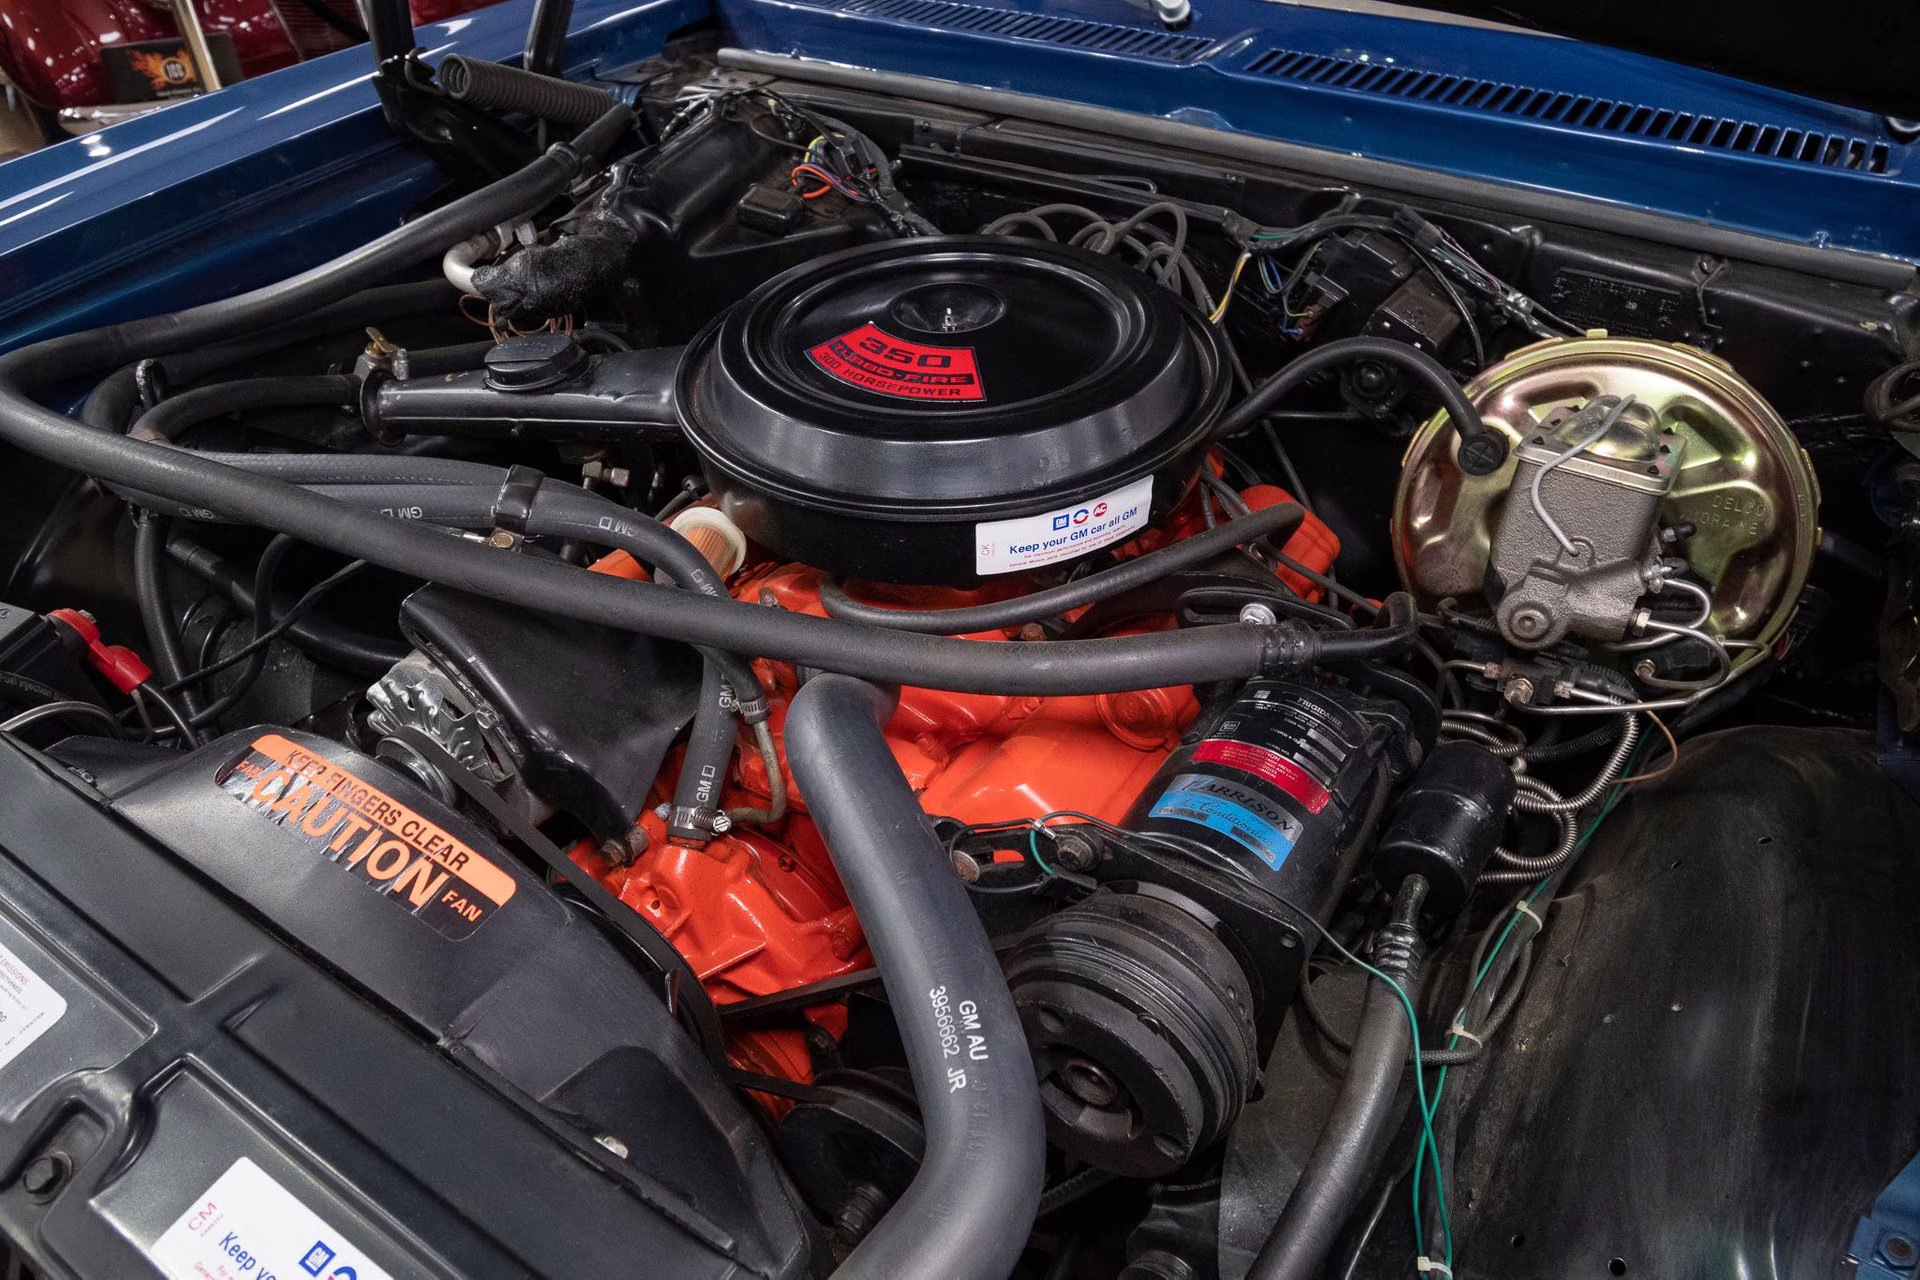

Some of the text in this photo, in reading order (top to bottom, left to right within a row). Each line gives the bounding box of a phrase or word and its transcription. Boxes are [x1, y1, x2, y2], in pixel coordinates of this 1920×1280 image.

[859, 336, 951, 368] 350
[818, 352, 961, 397] 300 HORSEPOWER
[400, 506, 423, 520] GM
[1093, 503, 1108, 518] AC
[1009, 543, 1040, 555] Keep
[1042, 536, 1068, 550] your
[1070, 528, 1088, 541] GM
[1090, 523, 1107, 535] car
[1108, 515, 1120, 528] all
[1122, 507, 1138, 521] GM
[719, 684, 733, 708] GM
[697, 780, 713, 802] GM
[285, 749, 470, 872] KEEP FINGERS CLEAR
[252, 770, 450, 907] CAUTION
[441, 890, 483, 923] FAN
[960, 1000, 982, 1031] GM
[929, 985, 967, 1094] 3956662 JR
[967, 1034, 989, 1061] AU
[187, 1202, 218, 1232] CM
[218, 1231, 257, 1271] Keep
